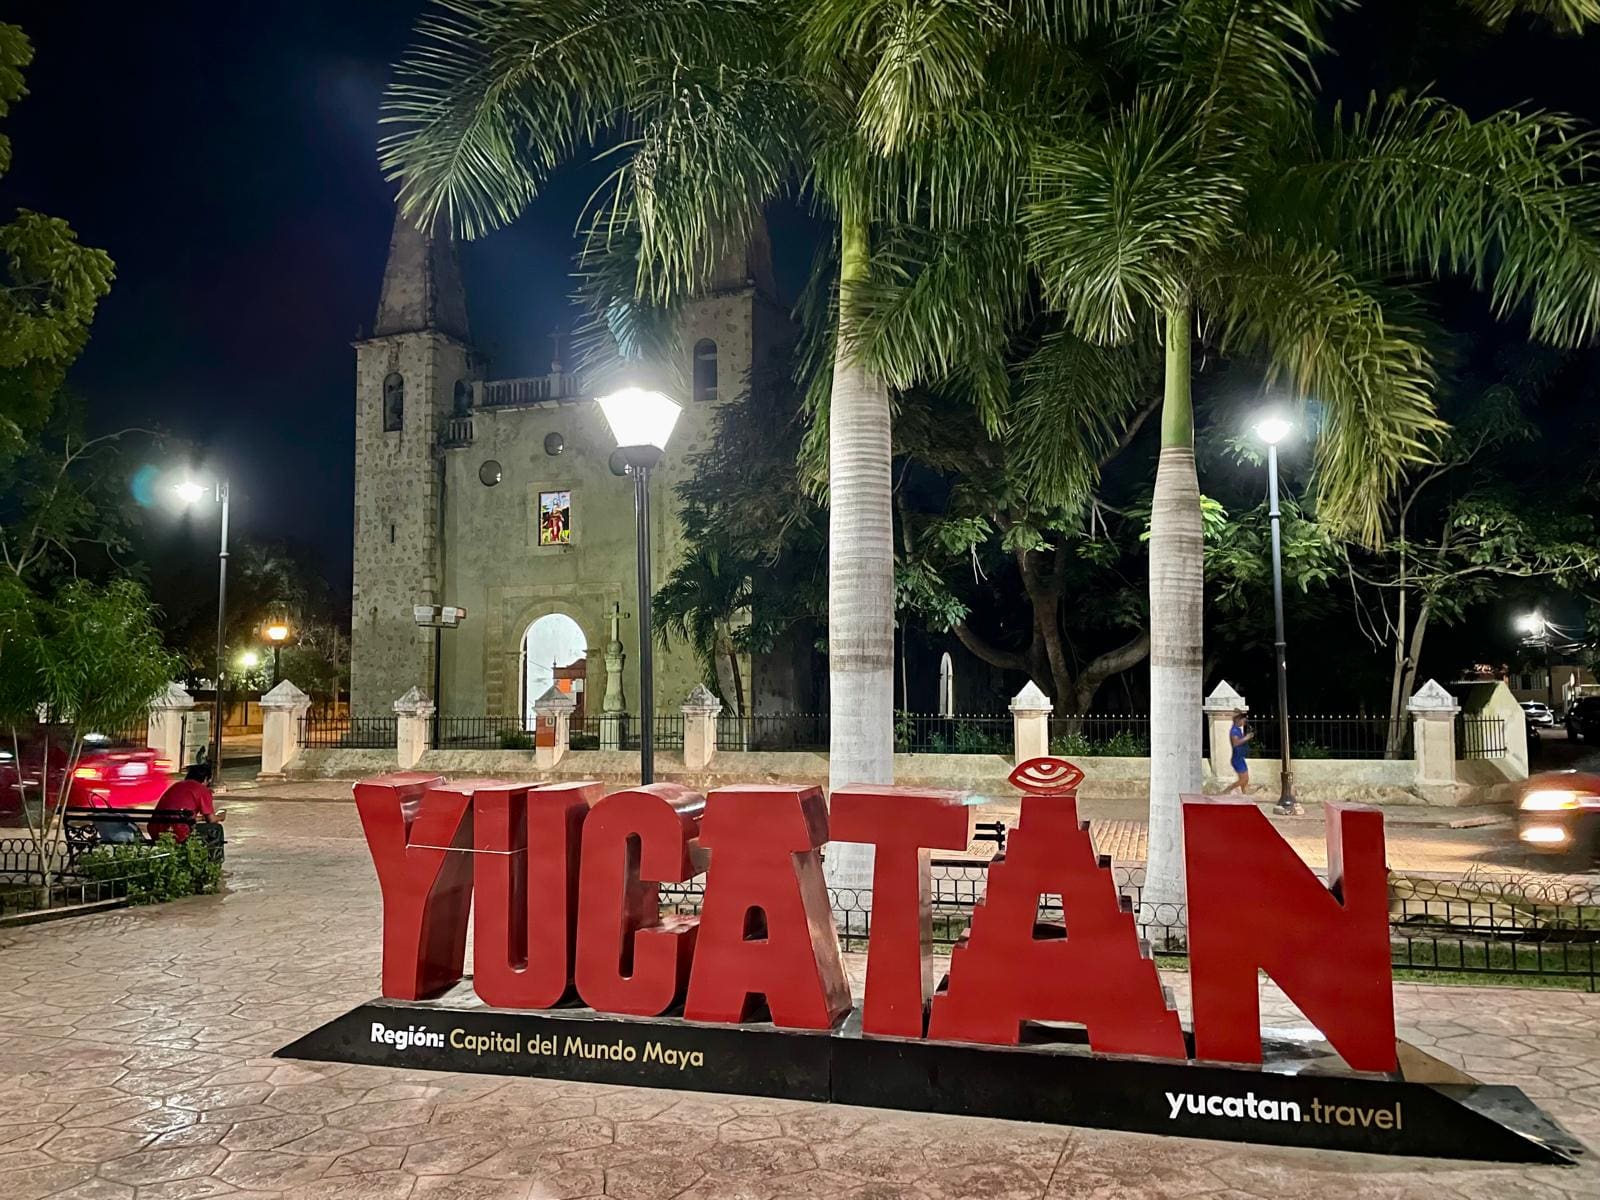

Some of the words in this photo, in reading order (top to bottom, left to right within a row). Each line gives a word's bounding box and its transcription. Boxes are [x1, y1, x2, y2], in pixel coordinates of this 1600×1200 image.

[370, 1022, 444, 1050] Región:
[449, 1028, 521, 1053] Capital
[527, 1034, 557, 1056] del
[562, 1037, 636, 1062] Mundo
[641, 1042, 704, 1070] Maya
[1165, 1091, 1402, 1130] yucatan.travel
